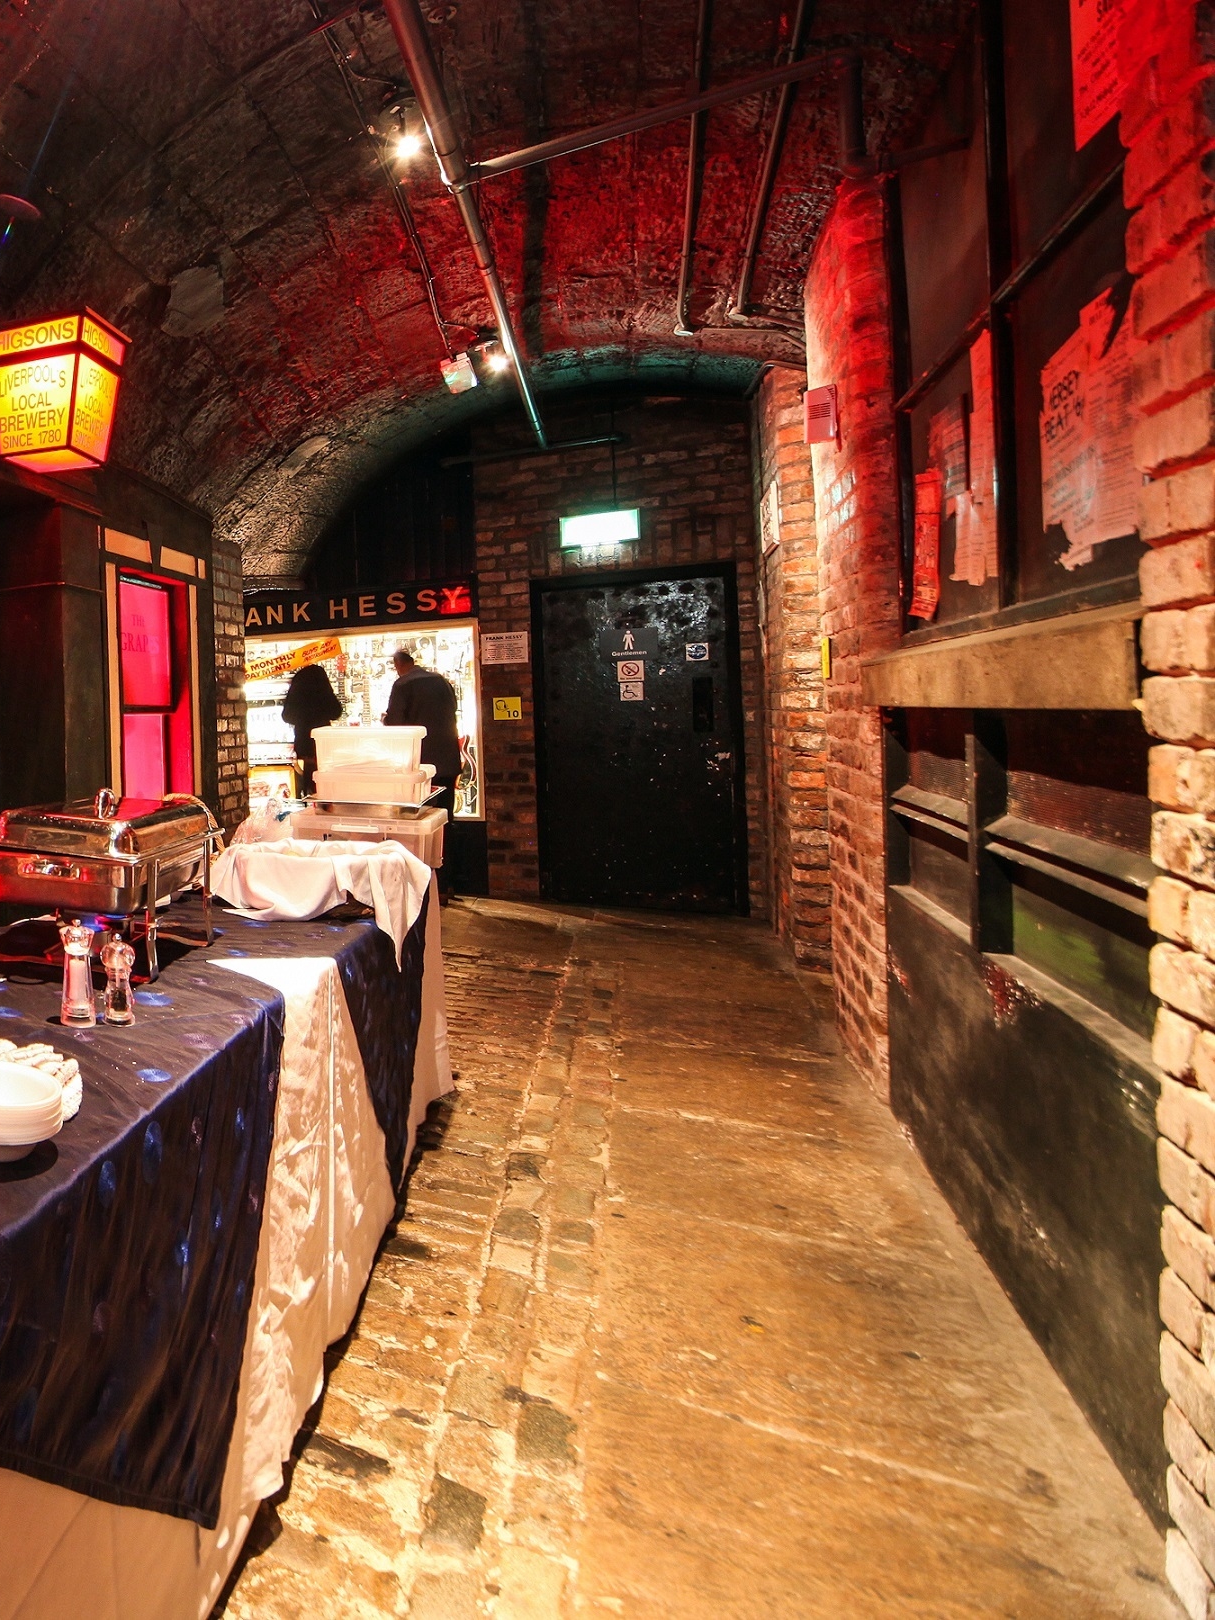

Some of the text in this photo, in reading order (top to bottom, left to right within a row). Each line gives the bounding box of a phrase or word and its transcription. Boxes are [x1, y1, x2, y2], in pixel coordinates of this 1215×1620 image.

[0, 365, 66, 397] LIVERPOOL'S
[12, 392, 52, 411] LOCAL
[85, 394, 104, 418] LOCAL
[0, 408, 65, 433] BREWERY
[3, 429, 62, 449] SINCE 1780
[329, 586, 464, 620] HESSY
[245, 661, 291, 680] PAYMENTS
[250, 652, 296, 671] MONTHLY
[506, 710, 519, 718] 10
